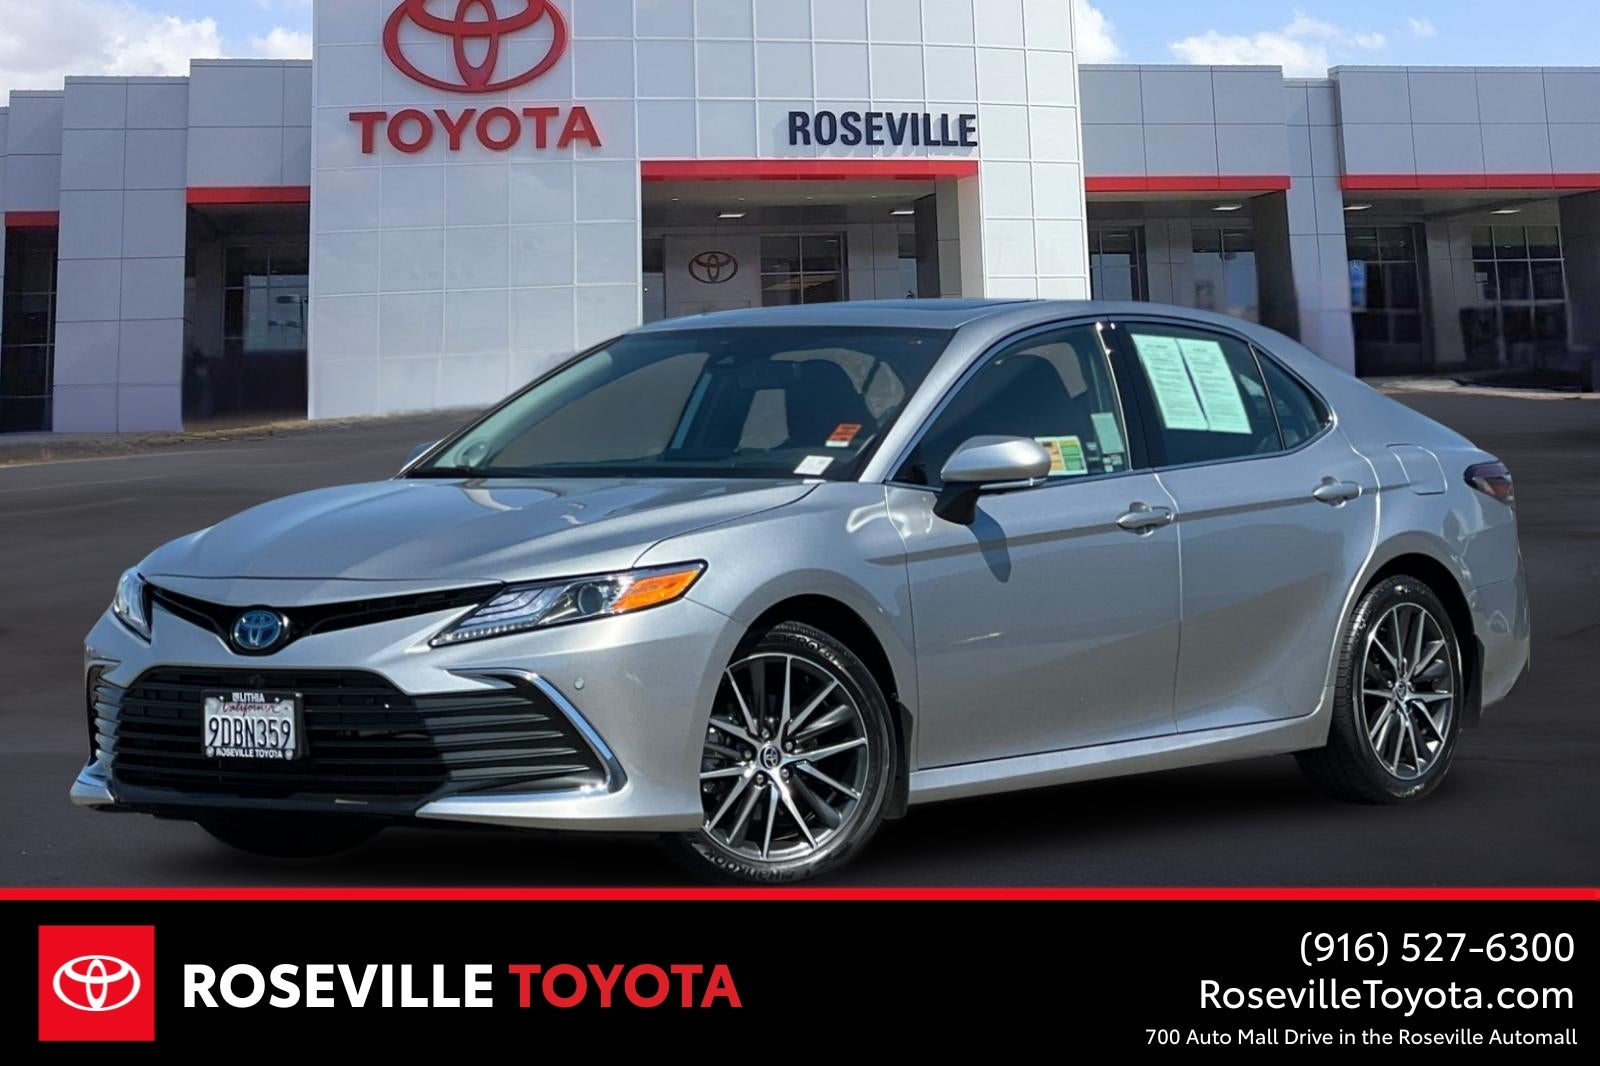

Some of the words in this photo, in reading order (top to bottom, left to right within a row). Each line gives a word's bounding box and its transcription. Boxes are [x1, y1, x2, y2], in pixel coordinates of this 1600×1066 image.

[350, 106, 602, 154] TOYOTA
[788, 110, 979, 148] ROSEVILLE
[239, 692, 265, 703] LITHIA
[223, 703, 280, 716] California
[208, 716, 292, 748] 9DBN359
[215, 748, 254, 758] ROSEVILLE
[255, 748, 284, 759] TOYOTA
